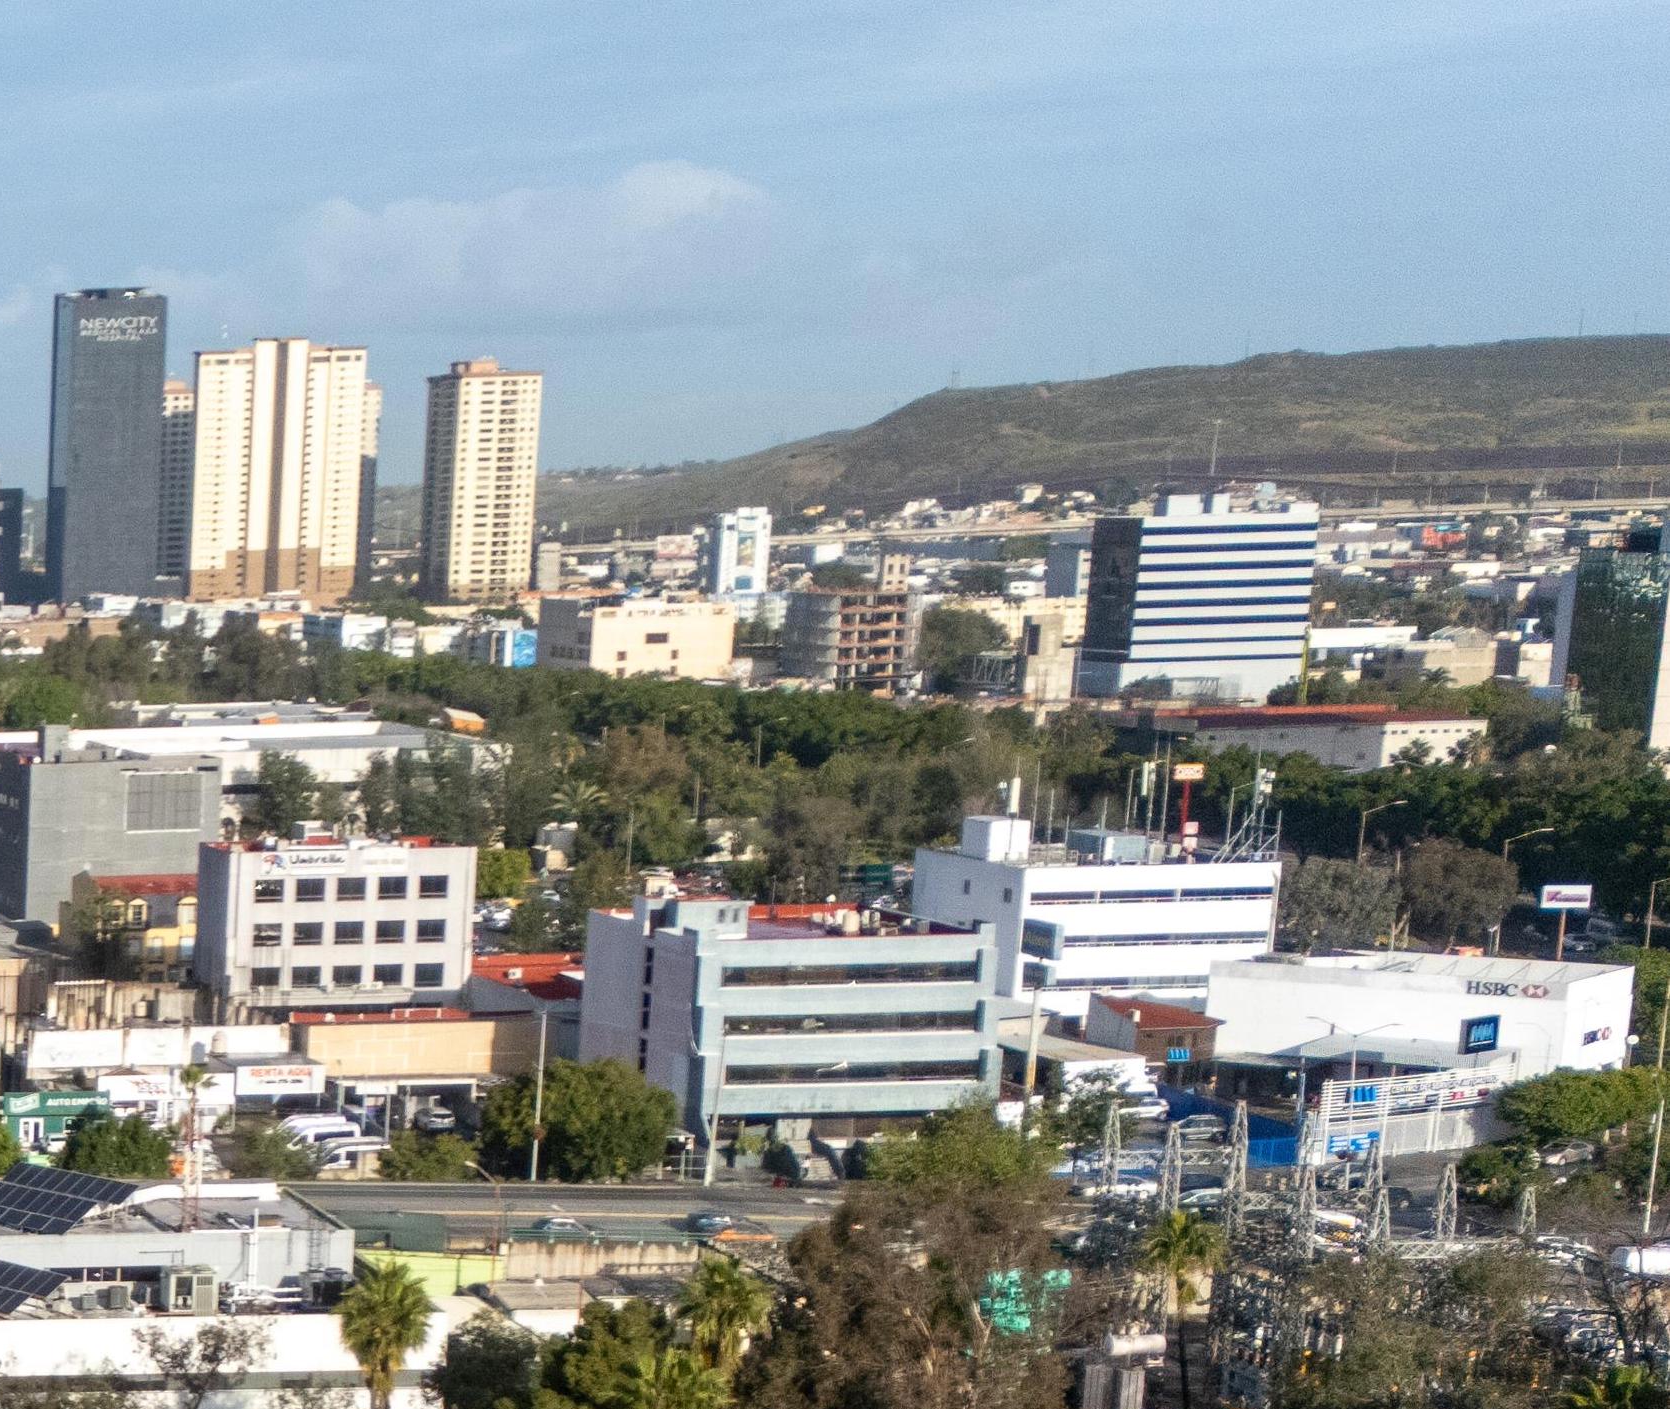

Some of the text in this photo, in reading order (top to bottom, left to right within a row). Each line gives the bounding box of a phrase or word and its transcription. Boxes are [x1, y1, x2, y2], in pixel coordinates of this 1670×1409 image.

[79, 315, 158, 329] NEWCITY
[1465, 979, 1519, 998] HSBC
[45, 1096, 71, 1107] AUTO
